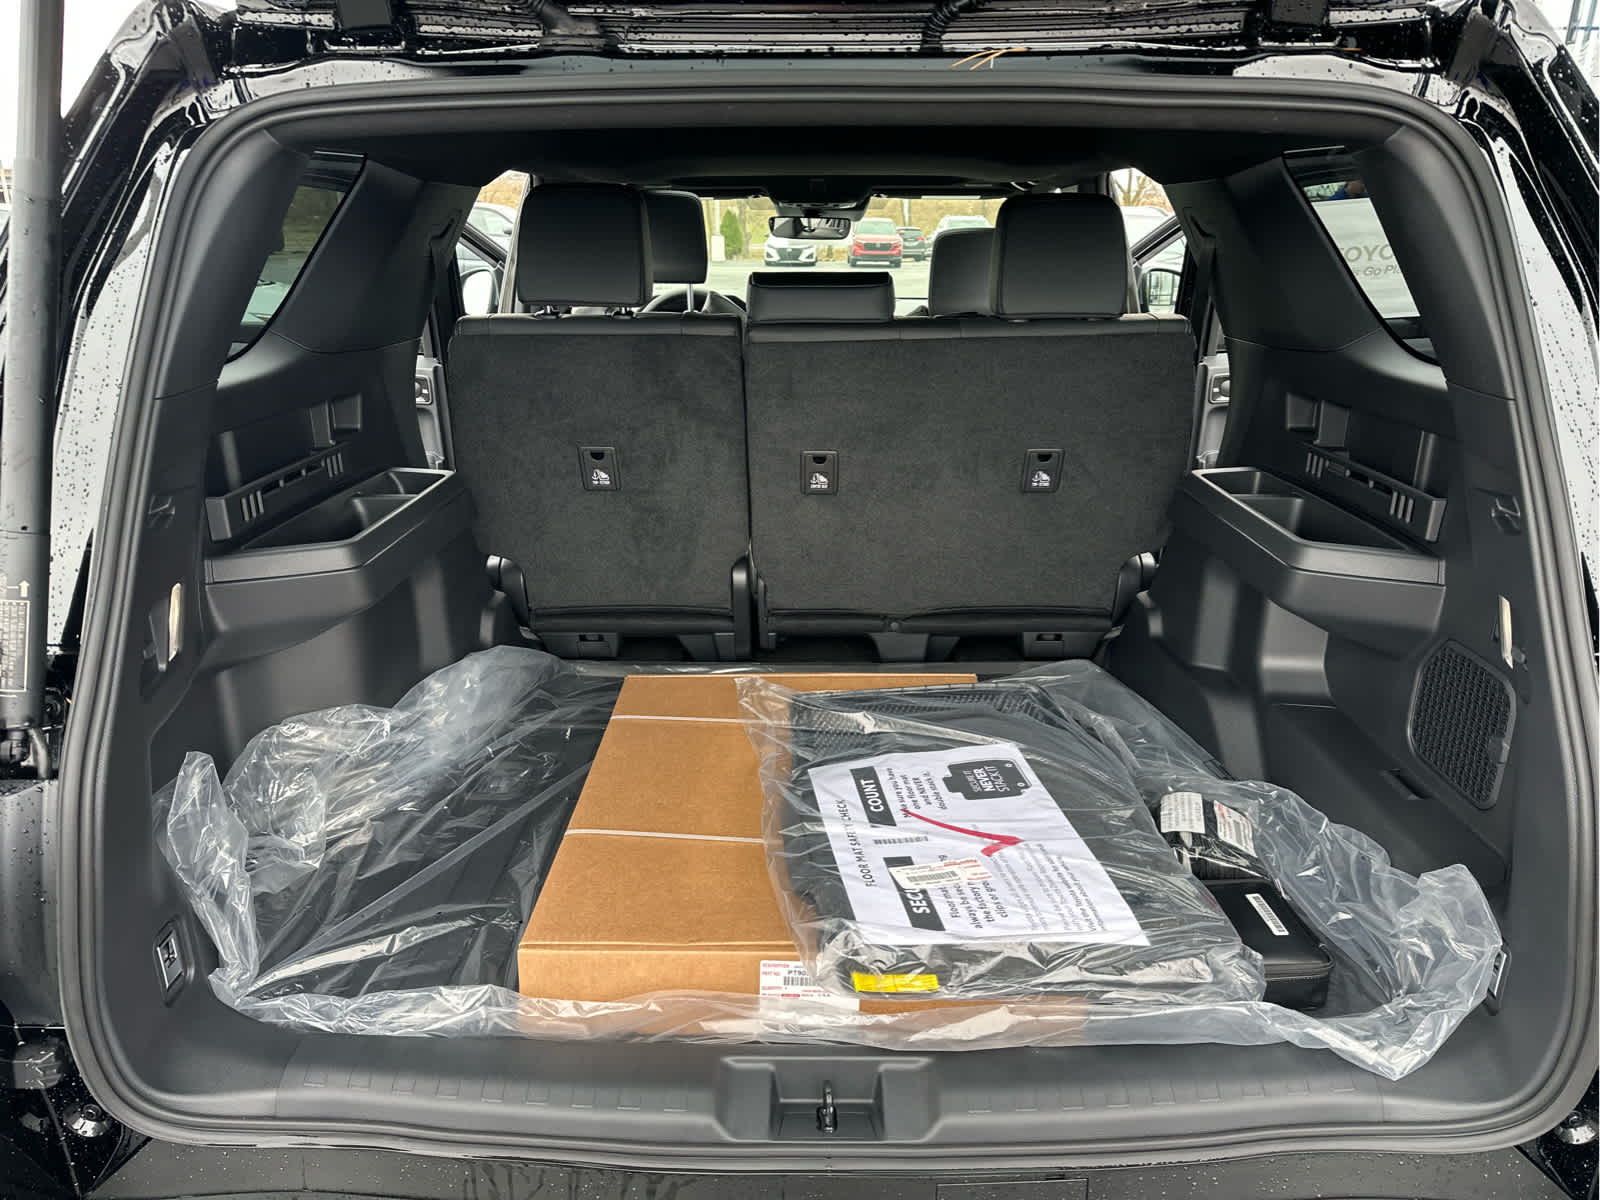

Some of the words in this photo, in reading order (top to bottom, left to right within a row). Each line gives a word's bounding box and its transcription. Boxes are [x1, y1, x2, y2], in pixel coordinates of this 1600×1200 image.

[887, 767, 896, 780] have
[973, 768, 995, 791] NEVER
[988, 771, 1010, 792] STACK
[892, 780, 902, 791] you
[905, 785, 916, 799] floor
[912, 777, 926, 794] NEVER
[861, 779, 884, 812] COUNT
[896, 791, 906, 803] sure
[934, 791, 948, 810] double
[912, 799, 921, 810] one
[844, 823, 861, 847] SAFEY
[852, 848, 866, 862] MAT
[859, 863, 875, 888] FLOOR
[960, 896, 970, 905] be
[969, 886, 987, 909] factory
[946, 900, 960, 918] Floor
[965, 905, 983, 929] always
[983, 910, 995, 922] the
[993, 901, 1008, 918] clips
